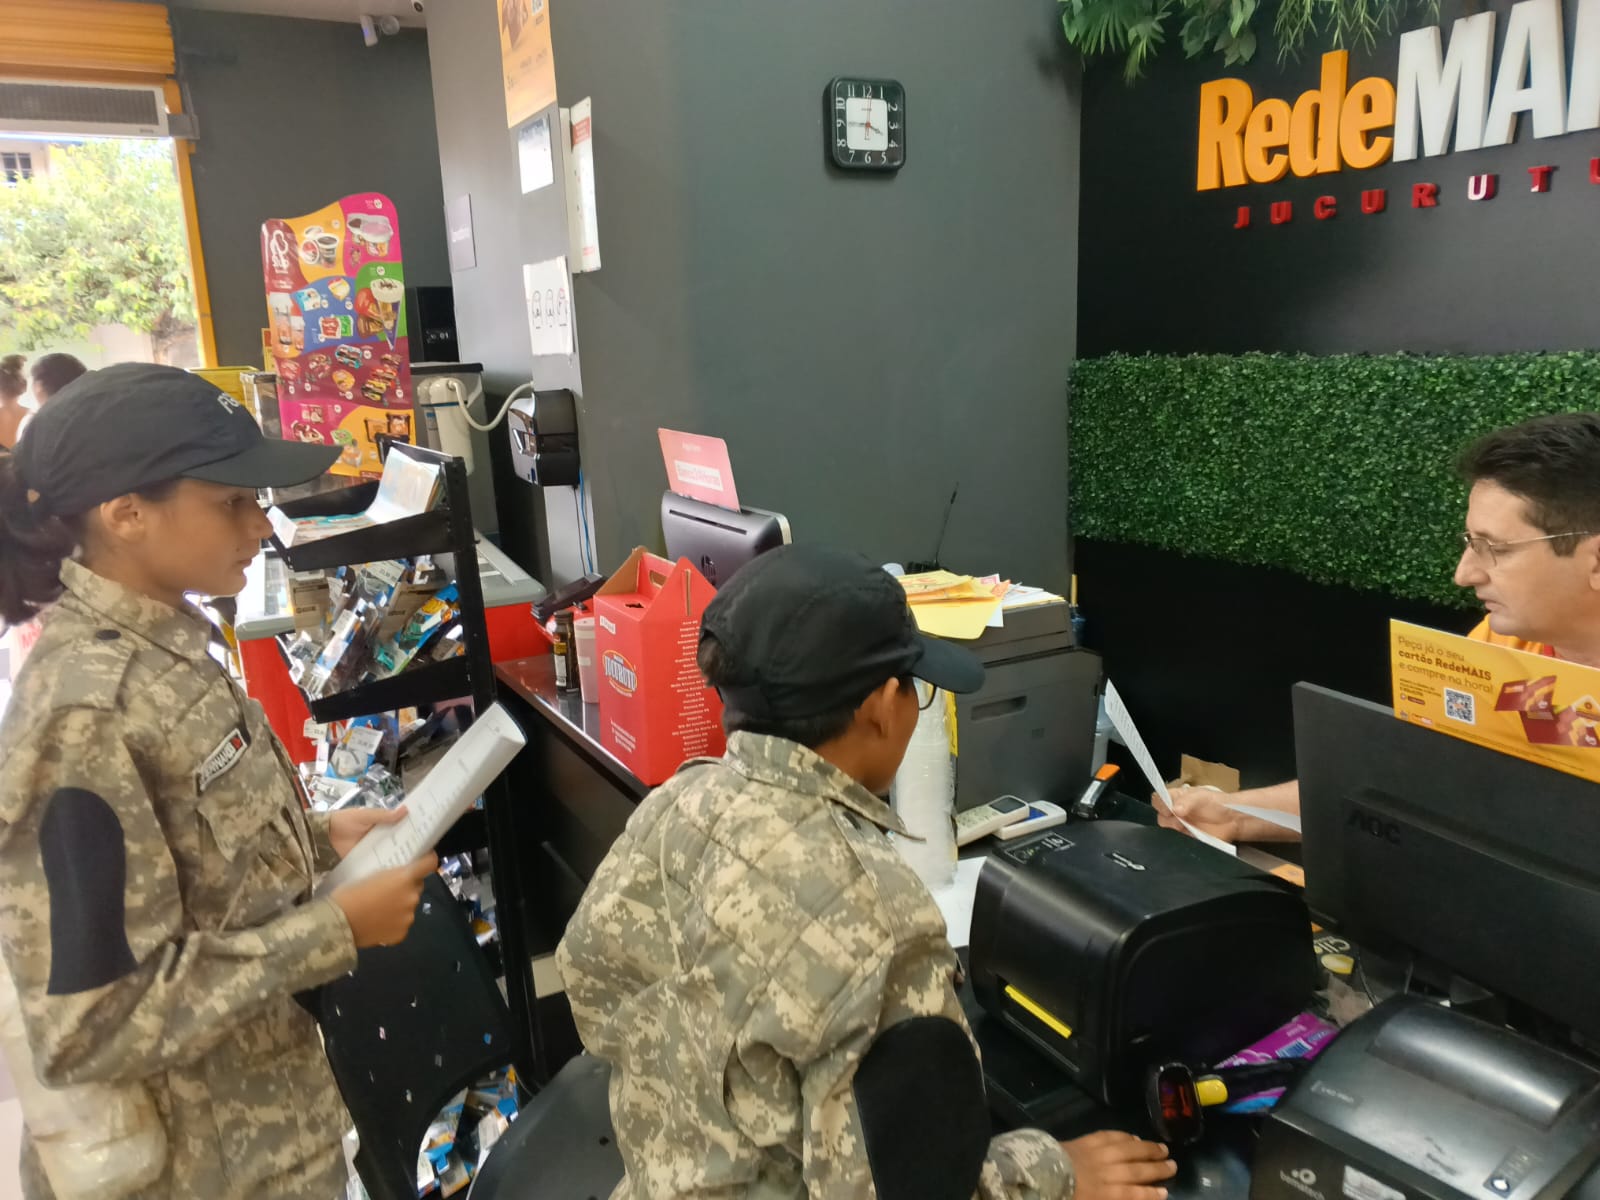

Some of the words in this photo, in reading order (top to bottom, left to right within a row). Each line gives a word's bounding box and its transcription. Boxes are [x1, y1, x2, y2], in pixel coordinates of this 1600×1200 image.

[862, 84, 872, 99] 12
[1398, 635, 1423, 651] Peça
[1425, 642, 1434, 654] já
[1437, 648, 1444, 656] o
[1446, 650, 1465, 662] seu
[1398, 650, 1433, 664] cartão
[1435, 657, 1492, 681] RedeMAIS
[1407, 664, 1447, 681] compre
[1448, 677, 1462, 686] na
